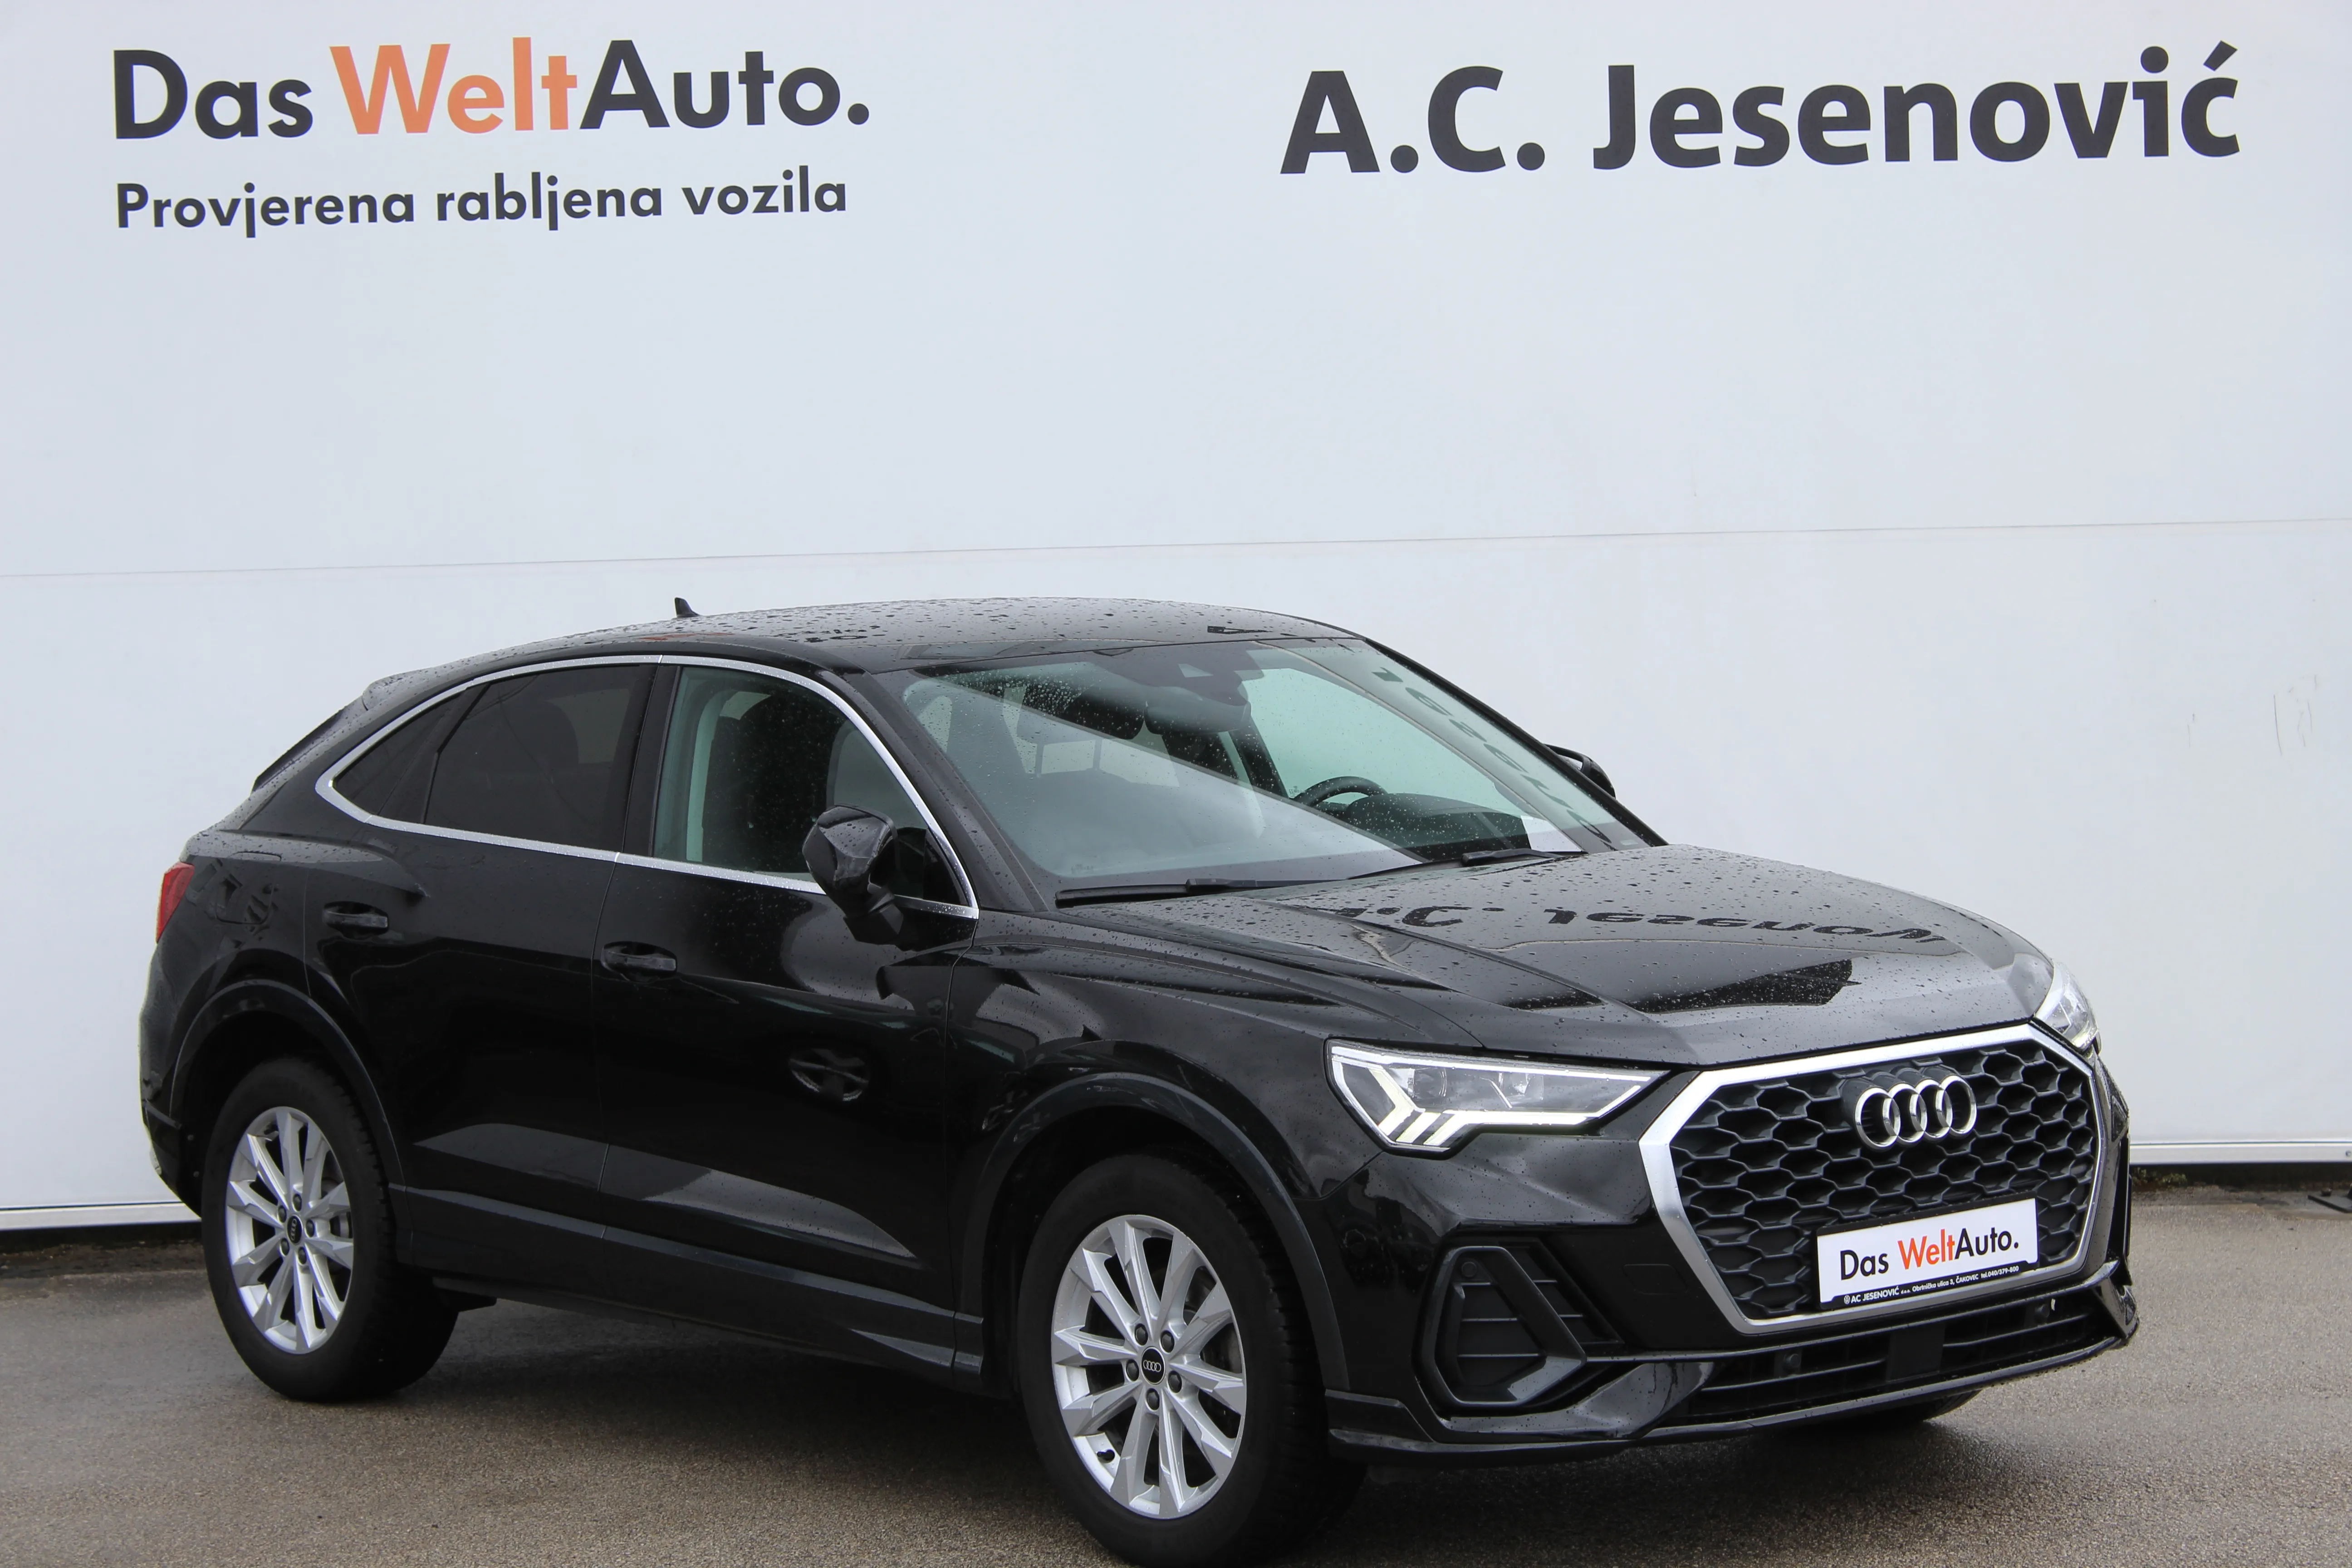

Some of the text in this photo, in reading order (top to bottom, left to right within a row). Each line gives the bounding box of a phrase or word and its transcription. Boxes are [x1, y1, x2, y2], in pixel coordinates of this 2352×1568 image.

[114, 38, 869, 139] Das WeltAuto.
[1280, 40, 2240, 174] A.C. Jesenović
[118, 165, 846, 238] Provjerena rabljena vozila
[1840, 1226, 2019, 1280] Das WeltAuto.
[1851, 1294, 1861, 1303] AC
[1862, 1285, 1900, 1301] JESENOVIĆ
[1912, 1282, 1936, 1292] Obrtnička
[1955, 1275, 1979, 1284] ČAKOVEC
